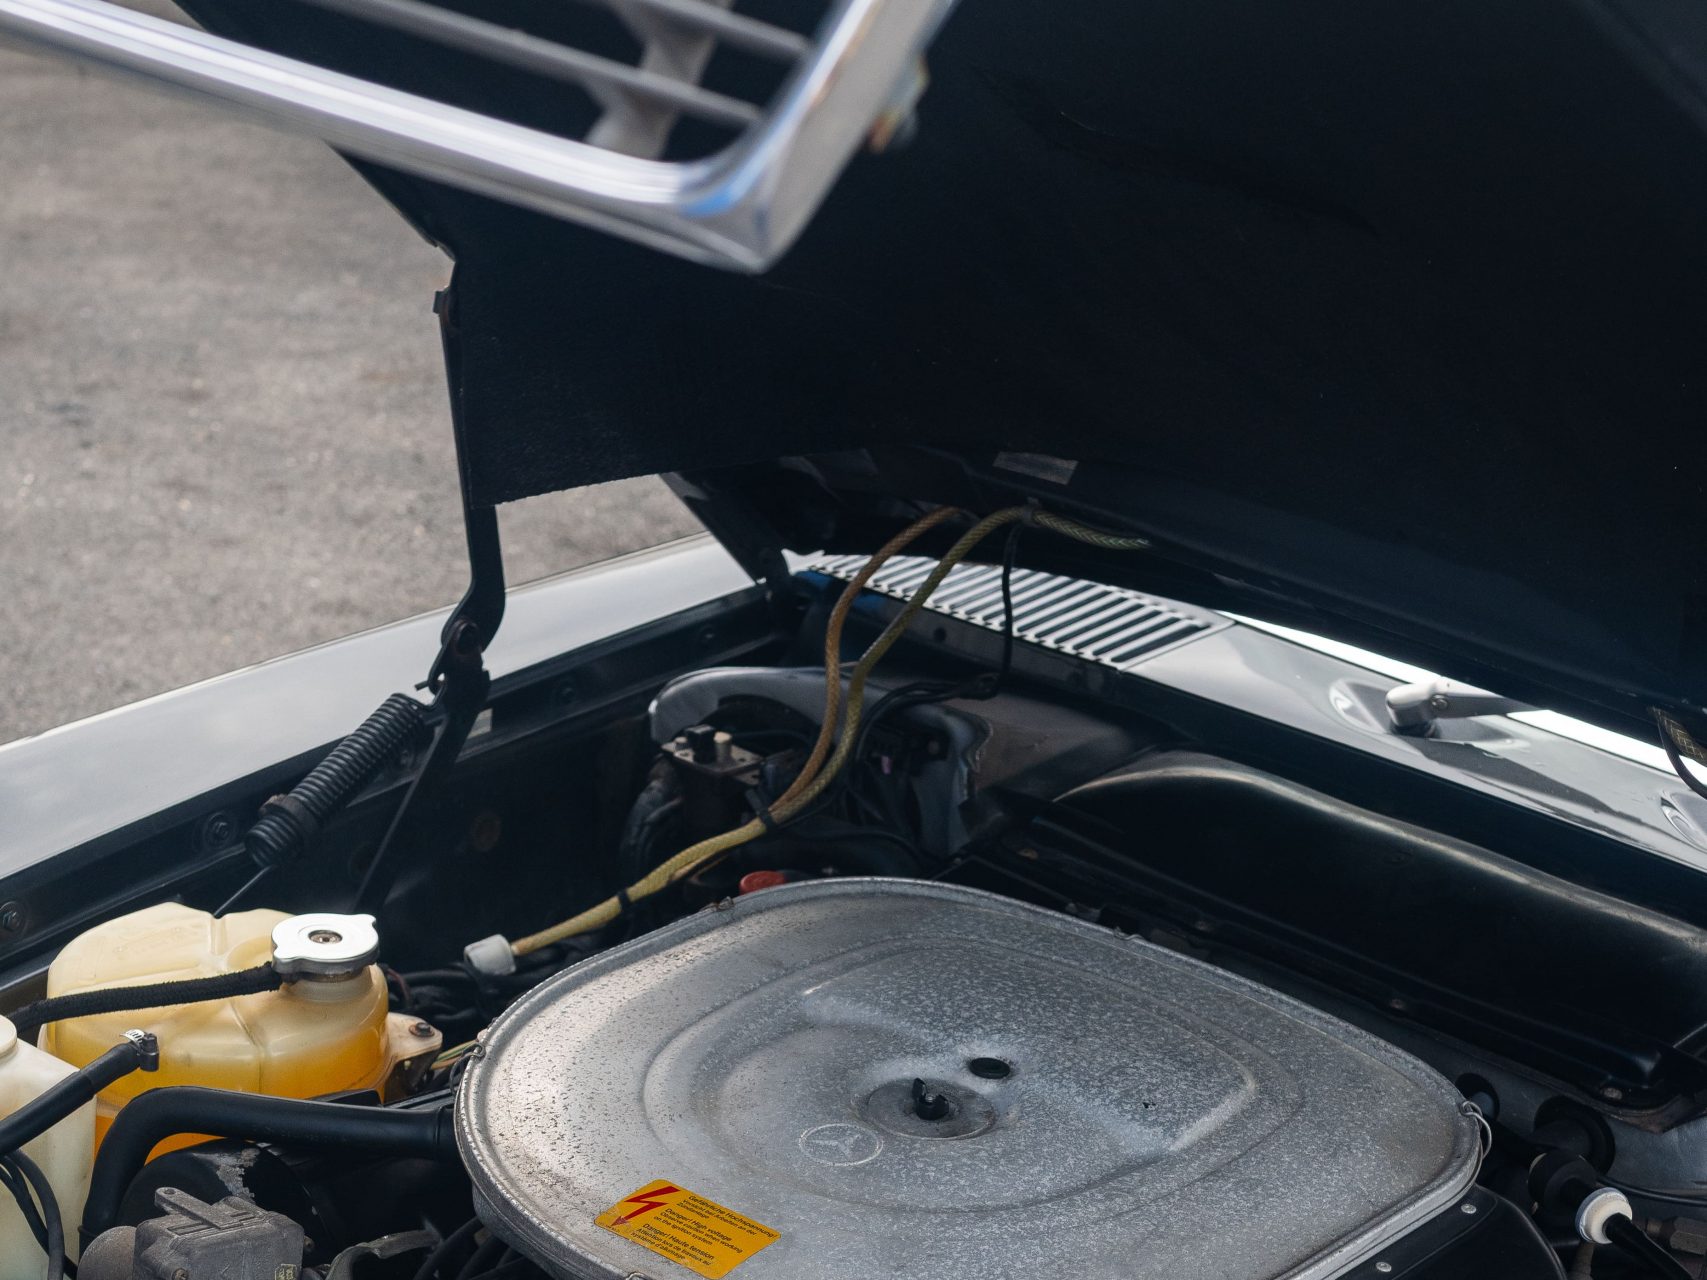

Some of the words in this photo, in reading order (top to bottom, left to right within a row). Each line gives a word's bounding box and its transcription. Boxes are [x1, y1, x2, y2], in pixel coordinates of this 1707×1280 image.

[660, 1212, 683, 1225] Observe
[704, 1232, 720, 1242] when
[720, 1240, 743, 1254] working
[665, 1208, 693, 1223] Danger!
[692, 1220, 706, 1230] High
[707, 1228, 732, 1242] voltage
[688, 1195, 726, 1214] Gefährliche
[726, 1212, 778, 1238] Hochspannung!
[636, 1228, 662, 1242] Attention
[642, 1223, 670, 1240] Danger!
[670, 1235, 689, 1248] Haute
[689, 1243, 714, 1260] tension
[671, 1224, 692, 1236] ignition
[692, 1233, 713, 1246] system
